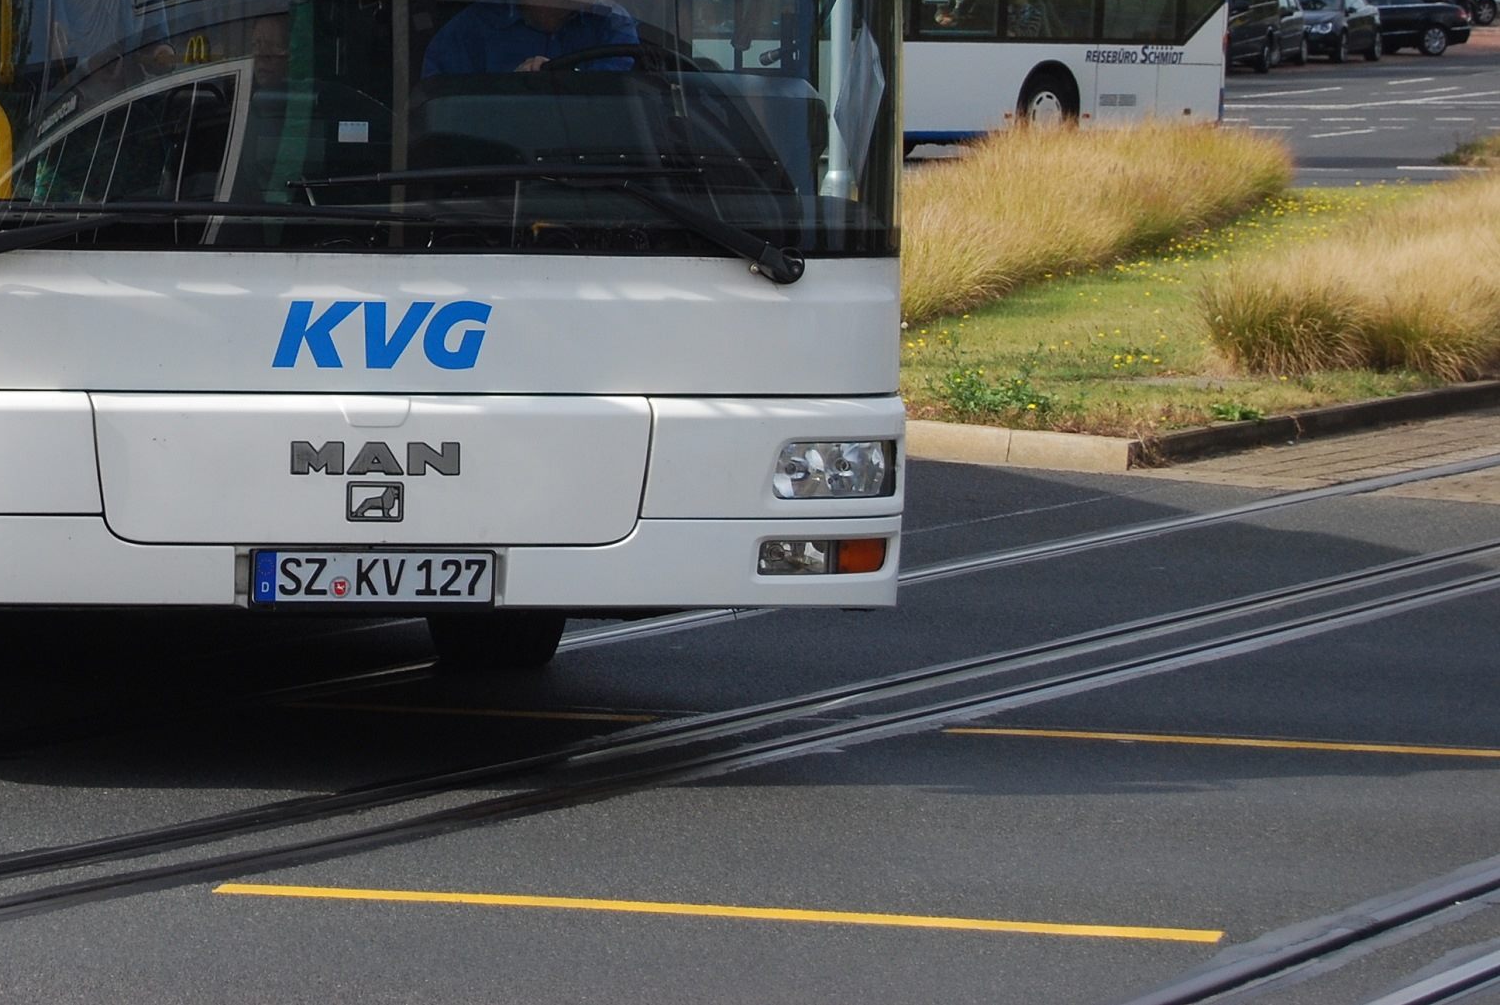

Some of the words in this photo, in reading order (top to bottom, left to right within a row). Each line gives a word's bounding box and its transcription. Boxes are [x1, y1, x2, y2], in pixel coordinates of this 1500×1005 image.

[1084, 48, 1138, 65] REISEBÜRO
[271, 300, 493, 371] KVG
[290, 440, 461, 476] MAN
[278, 557, 329, 596] SZ
[355, 558, 406, 597] KV
[415, 558, 488, 597] 127
